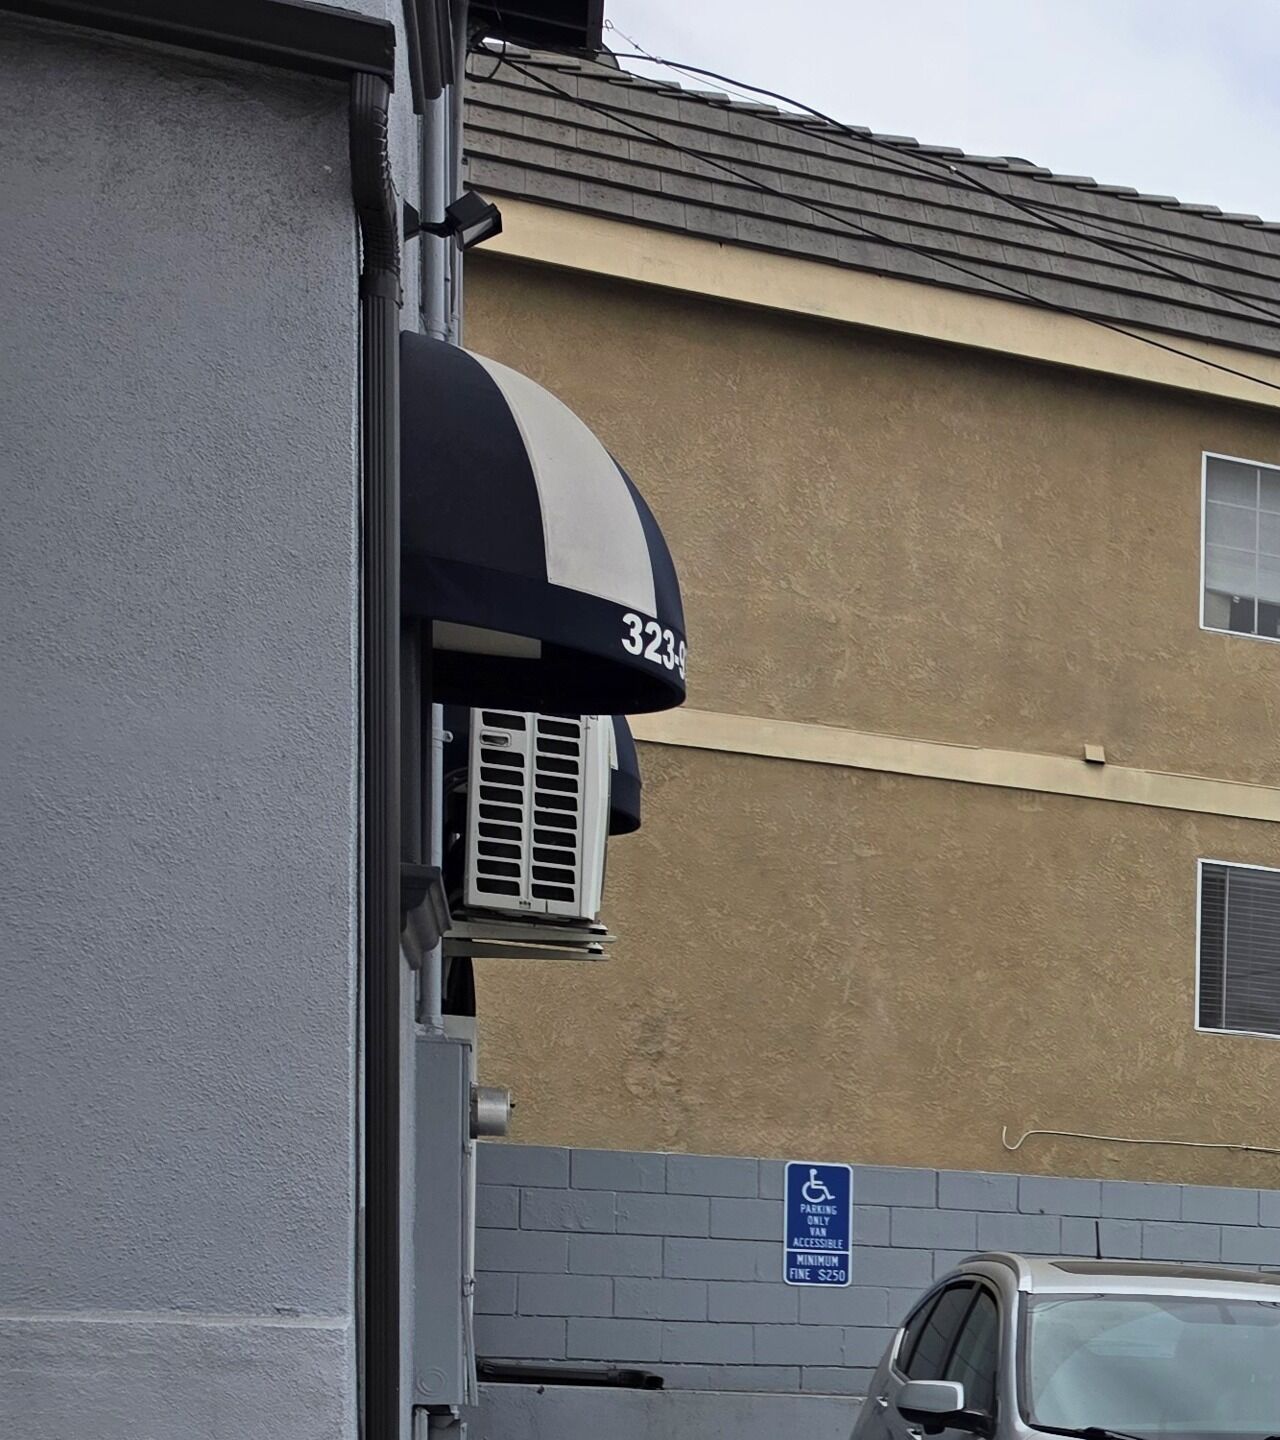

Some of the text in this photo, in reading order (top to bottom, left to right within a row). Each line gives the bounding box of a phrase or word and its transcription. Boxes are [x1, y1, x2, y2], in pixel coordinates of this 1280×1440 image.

[800, 1203, 838, 1215] PARKING
[807, 1215, 830, 1226] ONLY
[809, 1226, 827, 1237] VAN
[792, 1237, 844, 1249] ACCESSIBLE
[796, 1254, 839, 1267] MINIMUM
[789, 1267, 812, 1280] FINE
